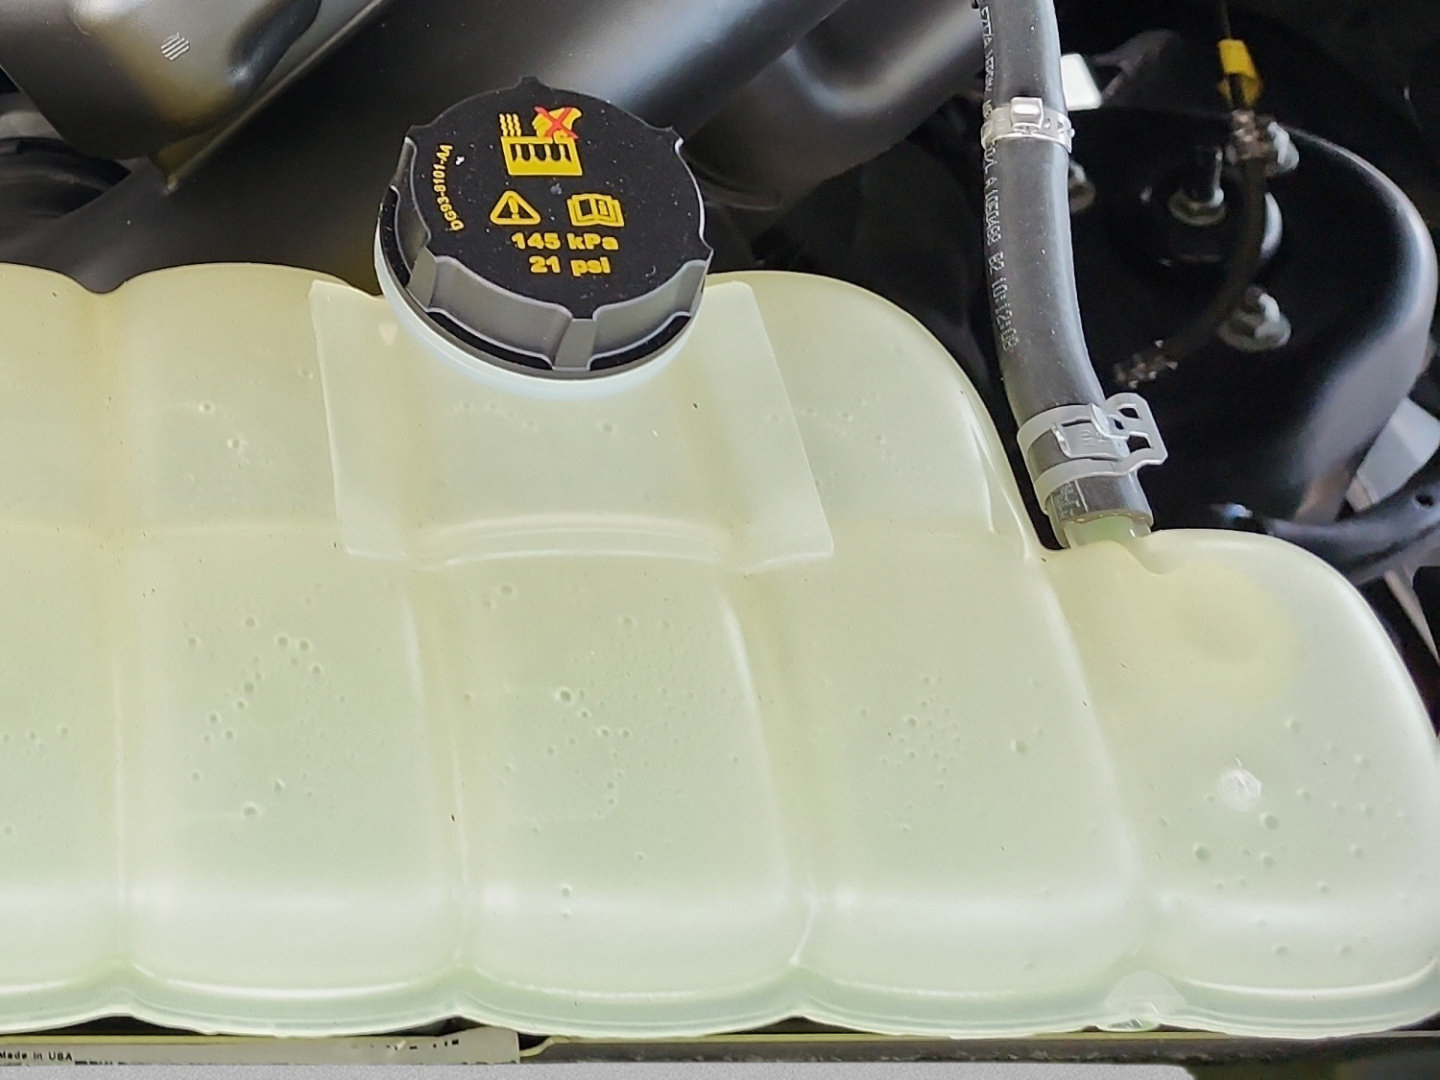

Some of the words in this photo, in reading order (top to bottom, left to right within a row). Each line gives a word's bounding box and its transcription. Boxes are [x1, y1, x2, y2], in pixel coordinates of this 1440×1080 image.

[431, 144, 464, 232] DG93-8101-AA
[511, 232, 560, 251] 145
[566, 232, 619, 251] kPa
[528, 256, 561, 274] 21
[570, 256, 611, 277] psi
[33, 1051, 43, 1061] in
[48, 1050, 73, 1062] USA
